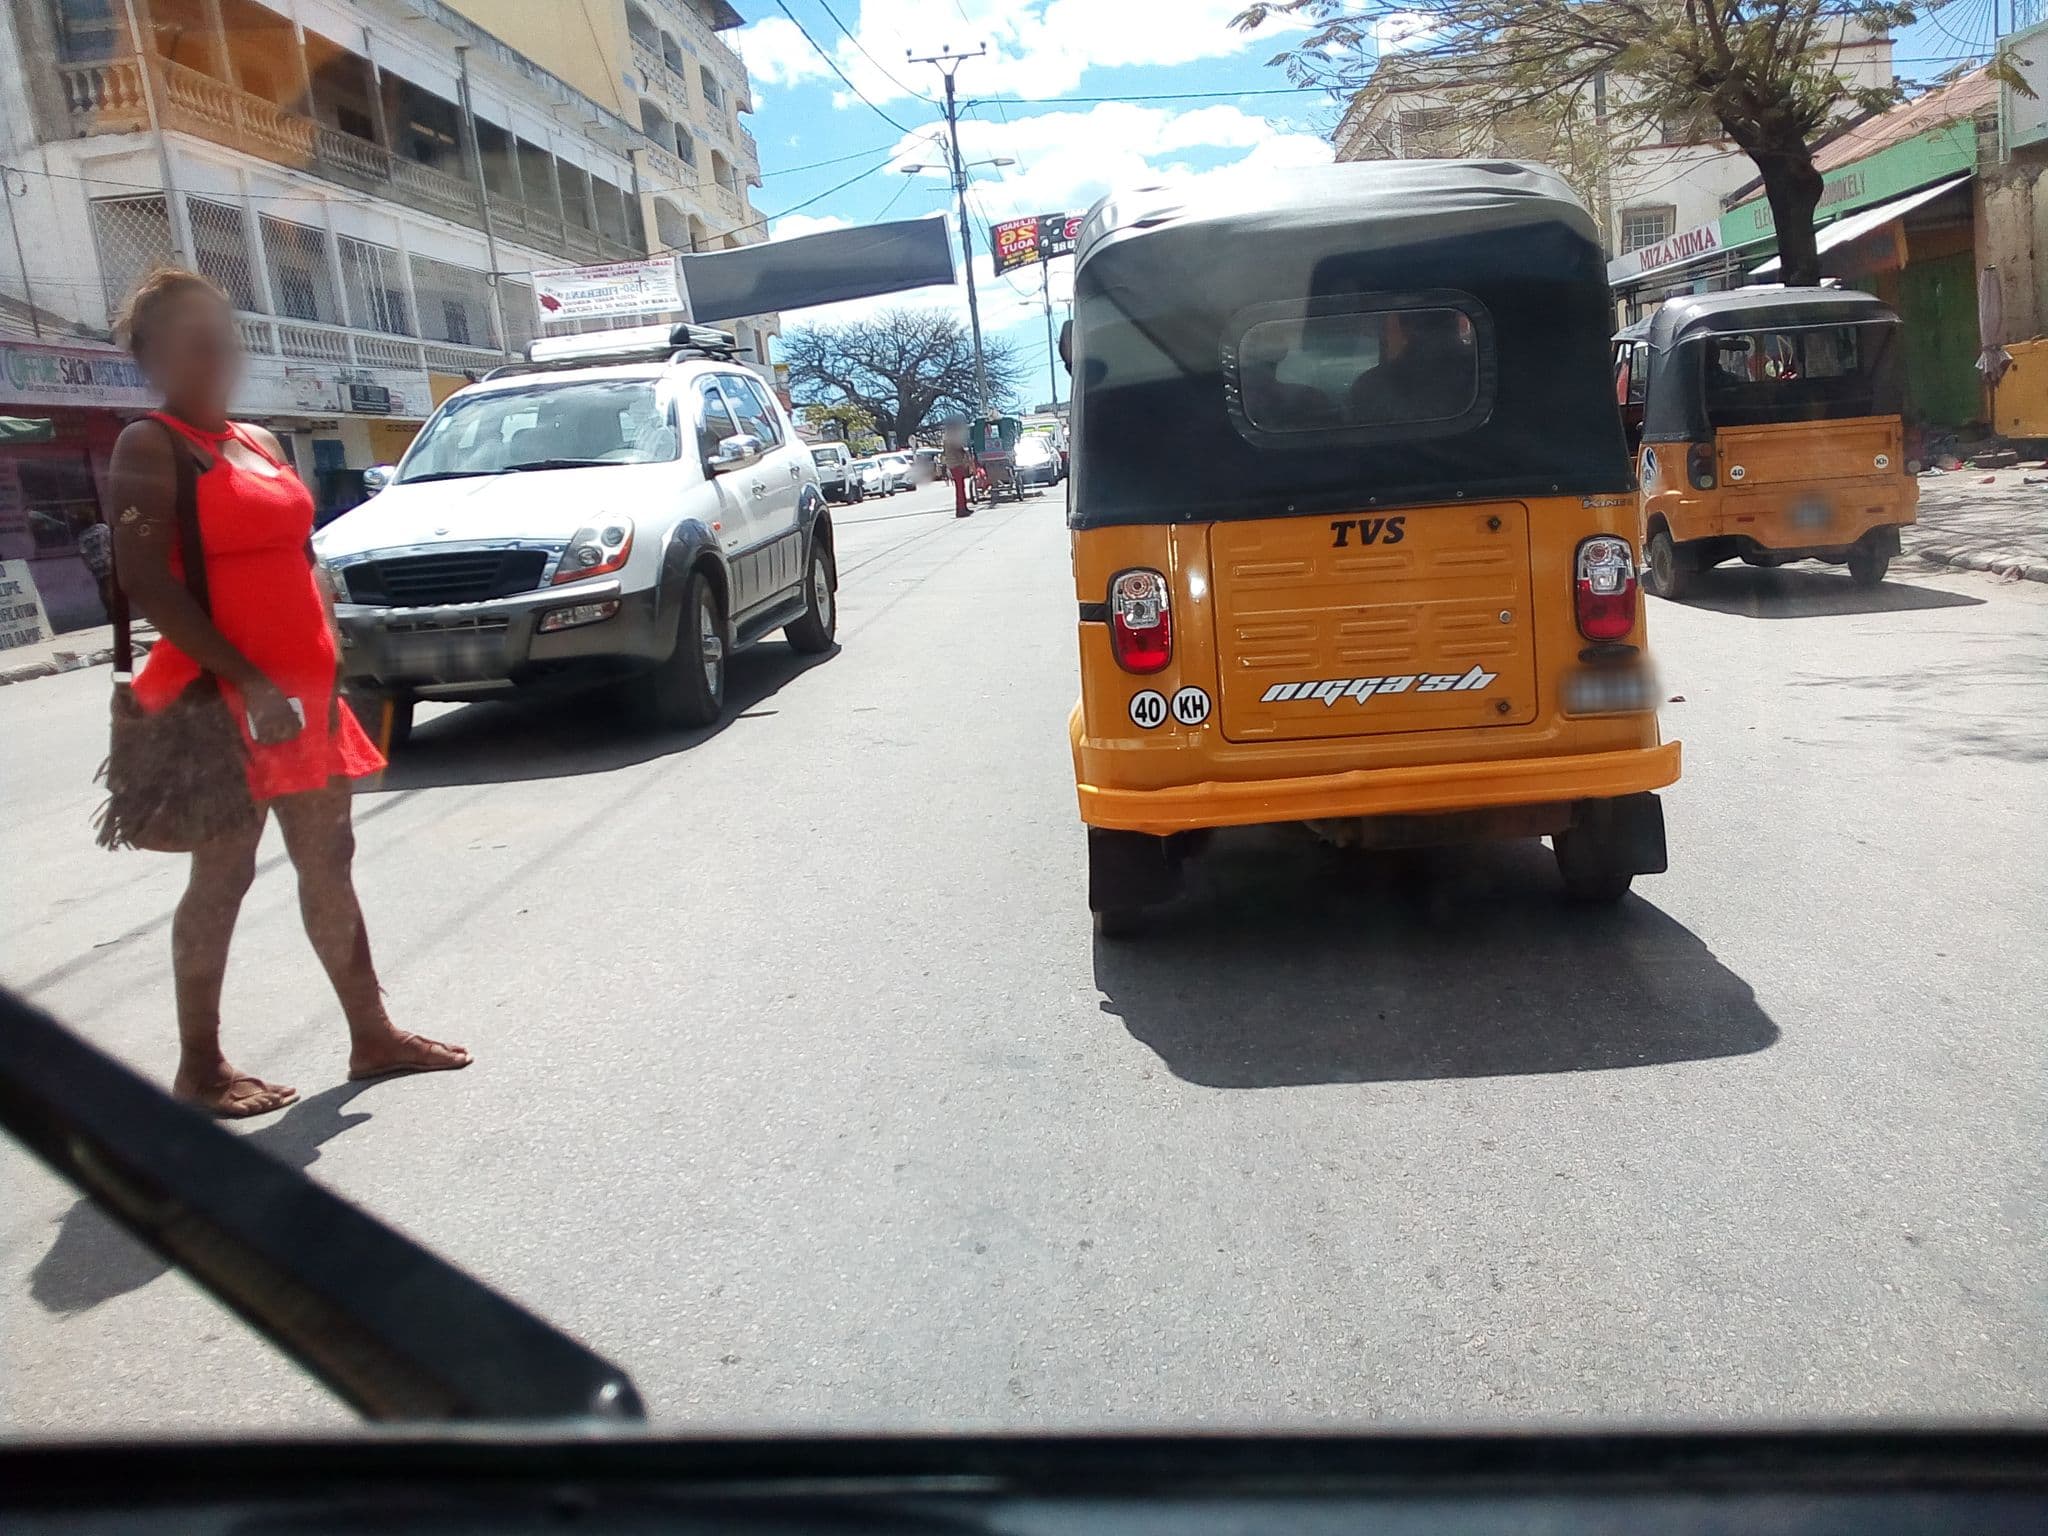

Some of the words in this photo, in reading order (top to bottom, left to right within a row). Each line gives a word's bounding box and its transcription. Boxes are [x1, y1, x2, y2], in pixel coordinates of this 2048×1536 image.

[1639, 243, 1674, 272] MIZA
[1672, 226, 1717, 259] MIMA
[1732, 468, 1744, 477] 40
[1330, 516, 1406, 548] TVS
[1134, 697, 1161, 723] 40
[1178, 695, 1205, 719] KH
